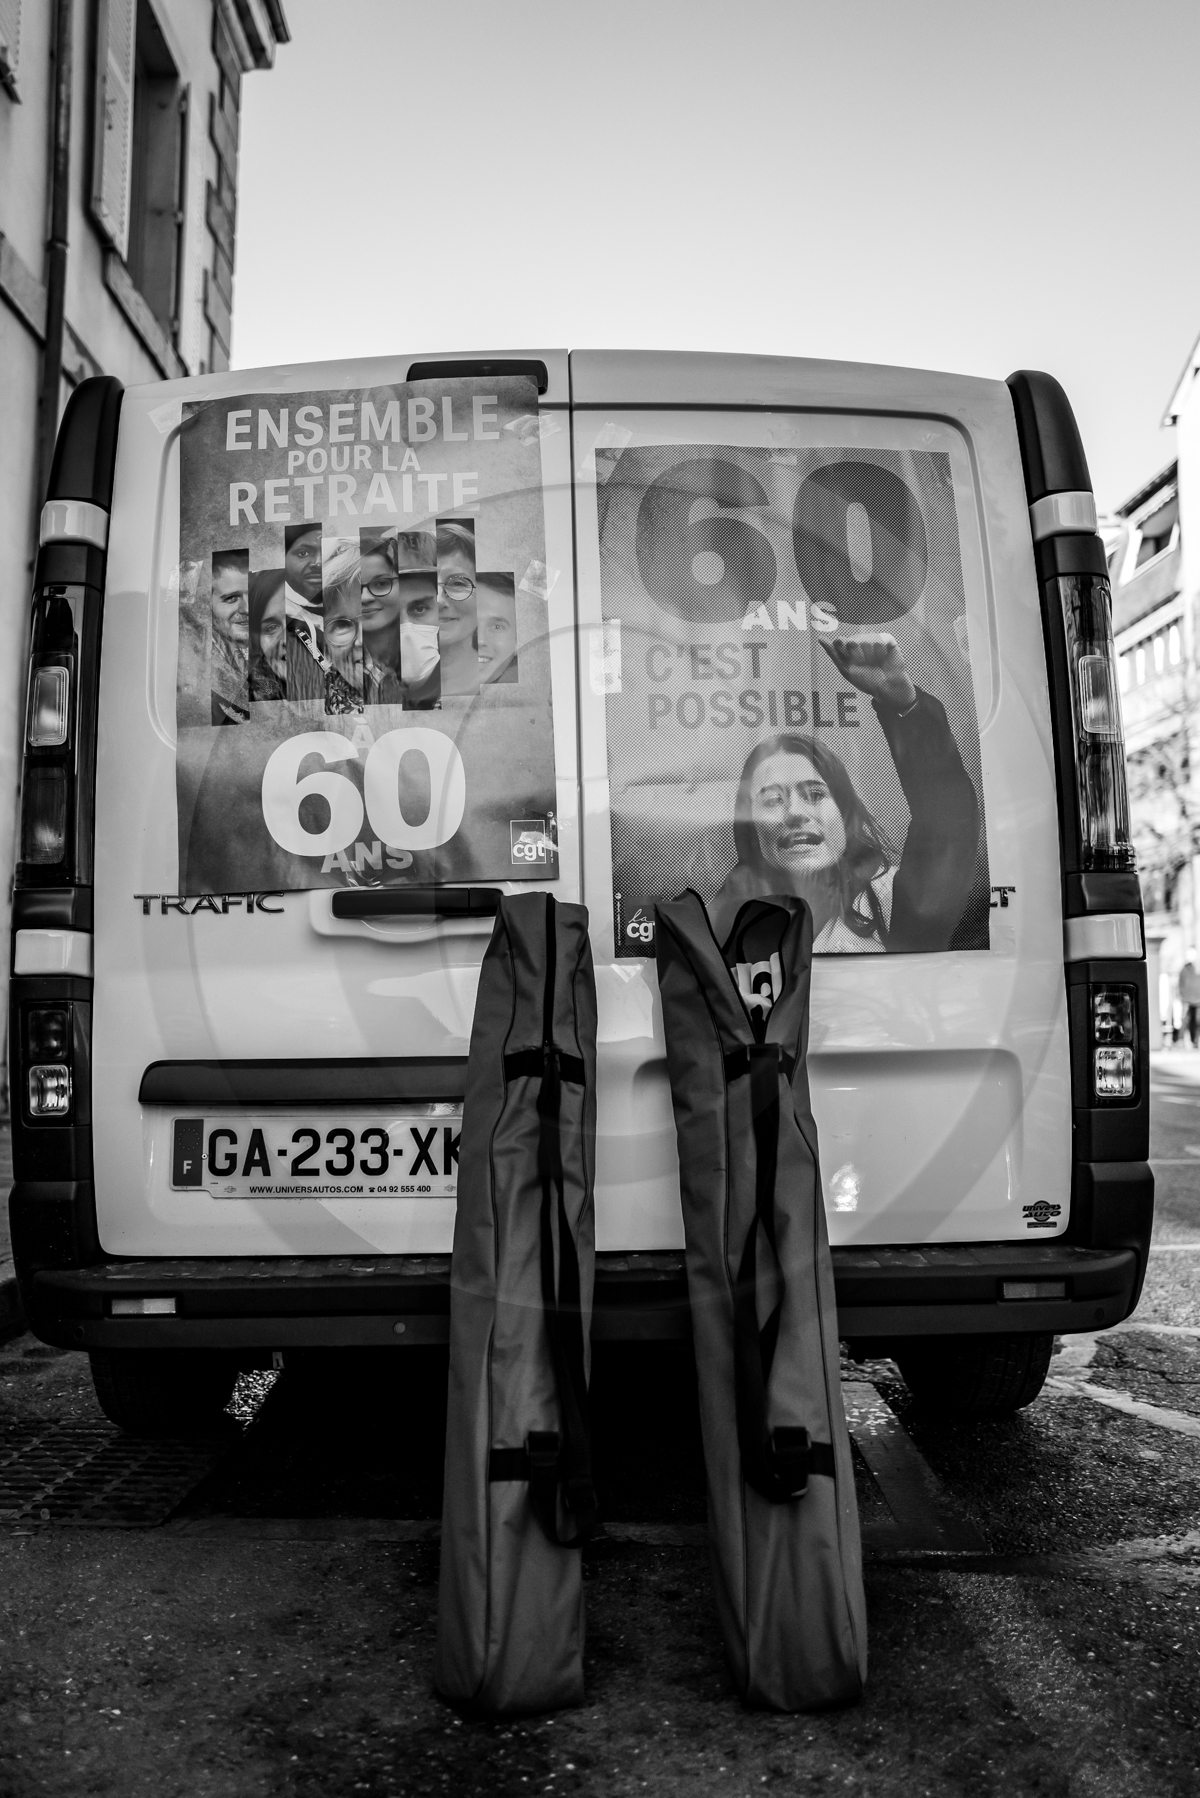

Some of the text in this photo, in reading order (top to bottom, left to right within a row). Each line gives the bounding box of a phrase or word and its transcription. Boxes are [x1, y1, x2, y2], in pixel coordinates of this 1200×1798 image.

[226, 395, 500, 450] ENSEMBLE
[287, 444, 422, 475] POUR LA
[229, 471, 480, 526] RETRAITE
[636, 458, 928, 625] 60
[741, 600, 839, 632] ANS
[646, 642, 768, 682] C'EST
[648, 690, 861, 730] POSSIBLE
[261, 727, 466, 857] 60
[320, 840, 413, 874] ANS
[512, 840, 545, 861] cgt
[133, 890, 285, 916] TRAFIC
[626, 922, 655, 943] cg
[182, 1160, 192, 1174] F
[207, 1127, 462, 1177] GA-233-XK
[249, 1185, 431, 1194] WWW.UNIVERSAUTOS.COM 04 92 555 400
